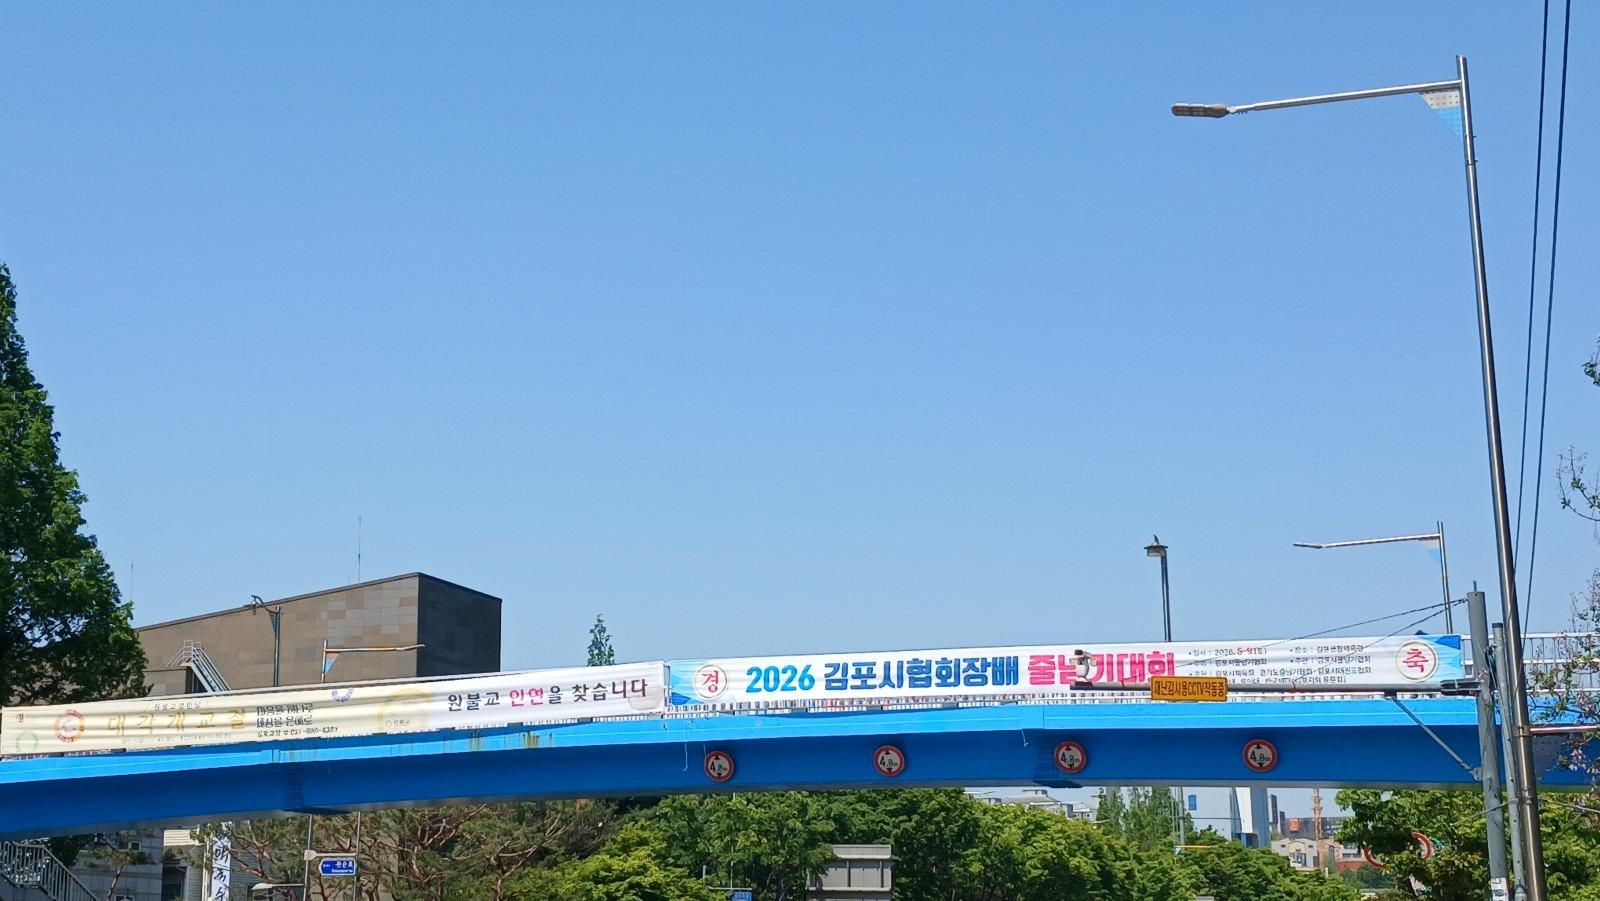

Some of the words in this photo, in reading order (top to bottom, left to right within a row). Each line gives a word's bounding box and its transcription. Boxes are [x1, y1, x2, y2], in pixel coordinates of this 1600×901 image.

[745, 664, 816, 693] 2026
[823, 655, 1020, 691] 김포시협회장배
[1402, 648, 1429, 673] 축
[447, 691, 501, 712] 원불교
[509, 685, 564, 708] 인연을
[571, 678, 648, 703] 찾습니다
[701, 669, 719, 693] 경
